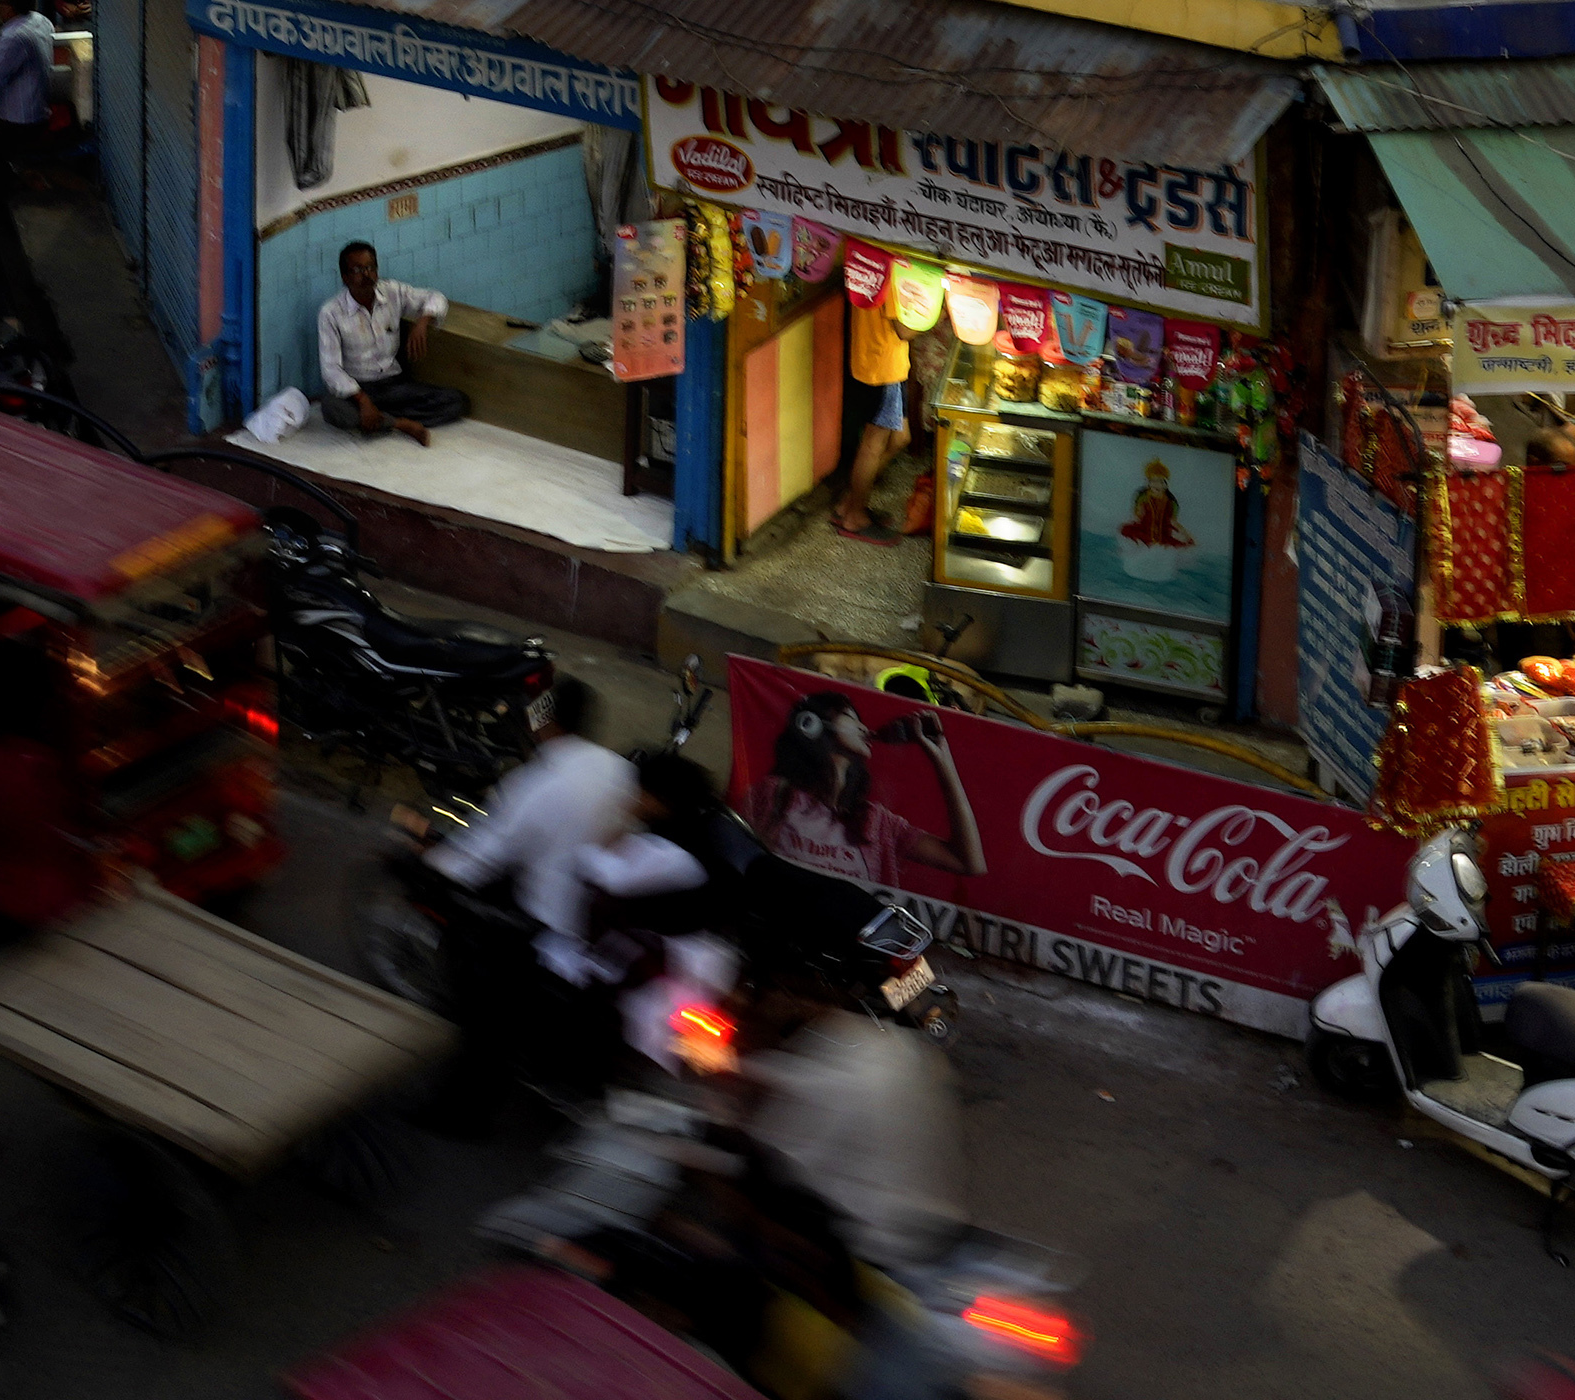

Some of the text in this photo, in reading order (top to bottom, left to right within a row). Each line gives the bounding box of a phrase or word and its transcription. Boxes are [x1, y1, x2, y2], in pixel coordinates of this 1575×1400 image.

[298, 13, 397, 69] अग्रवाल
[458, 45, 570, 106] अग्रवाल
[676, 137, 749, 185] Vadilal
[1099, 158, 1126, 200] &
[1172, 250, 1234, 282] Amul
[1020, 763, 1351, 924] Coca-Cola
[1089, 893, 1155, 934] Real
[1049, 938, 1227, 1016] SWEETS
